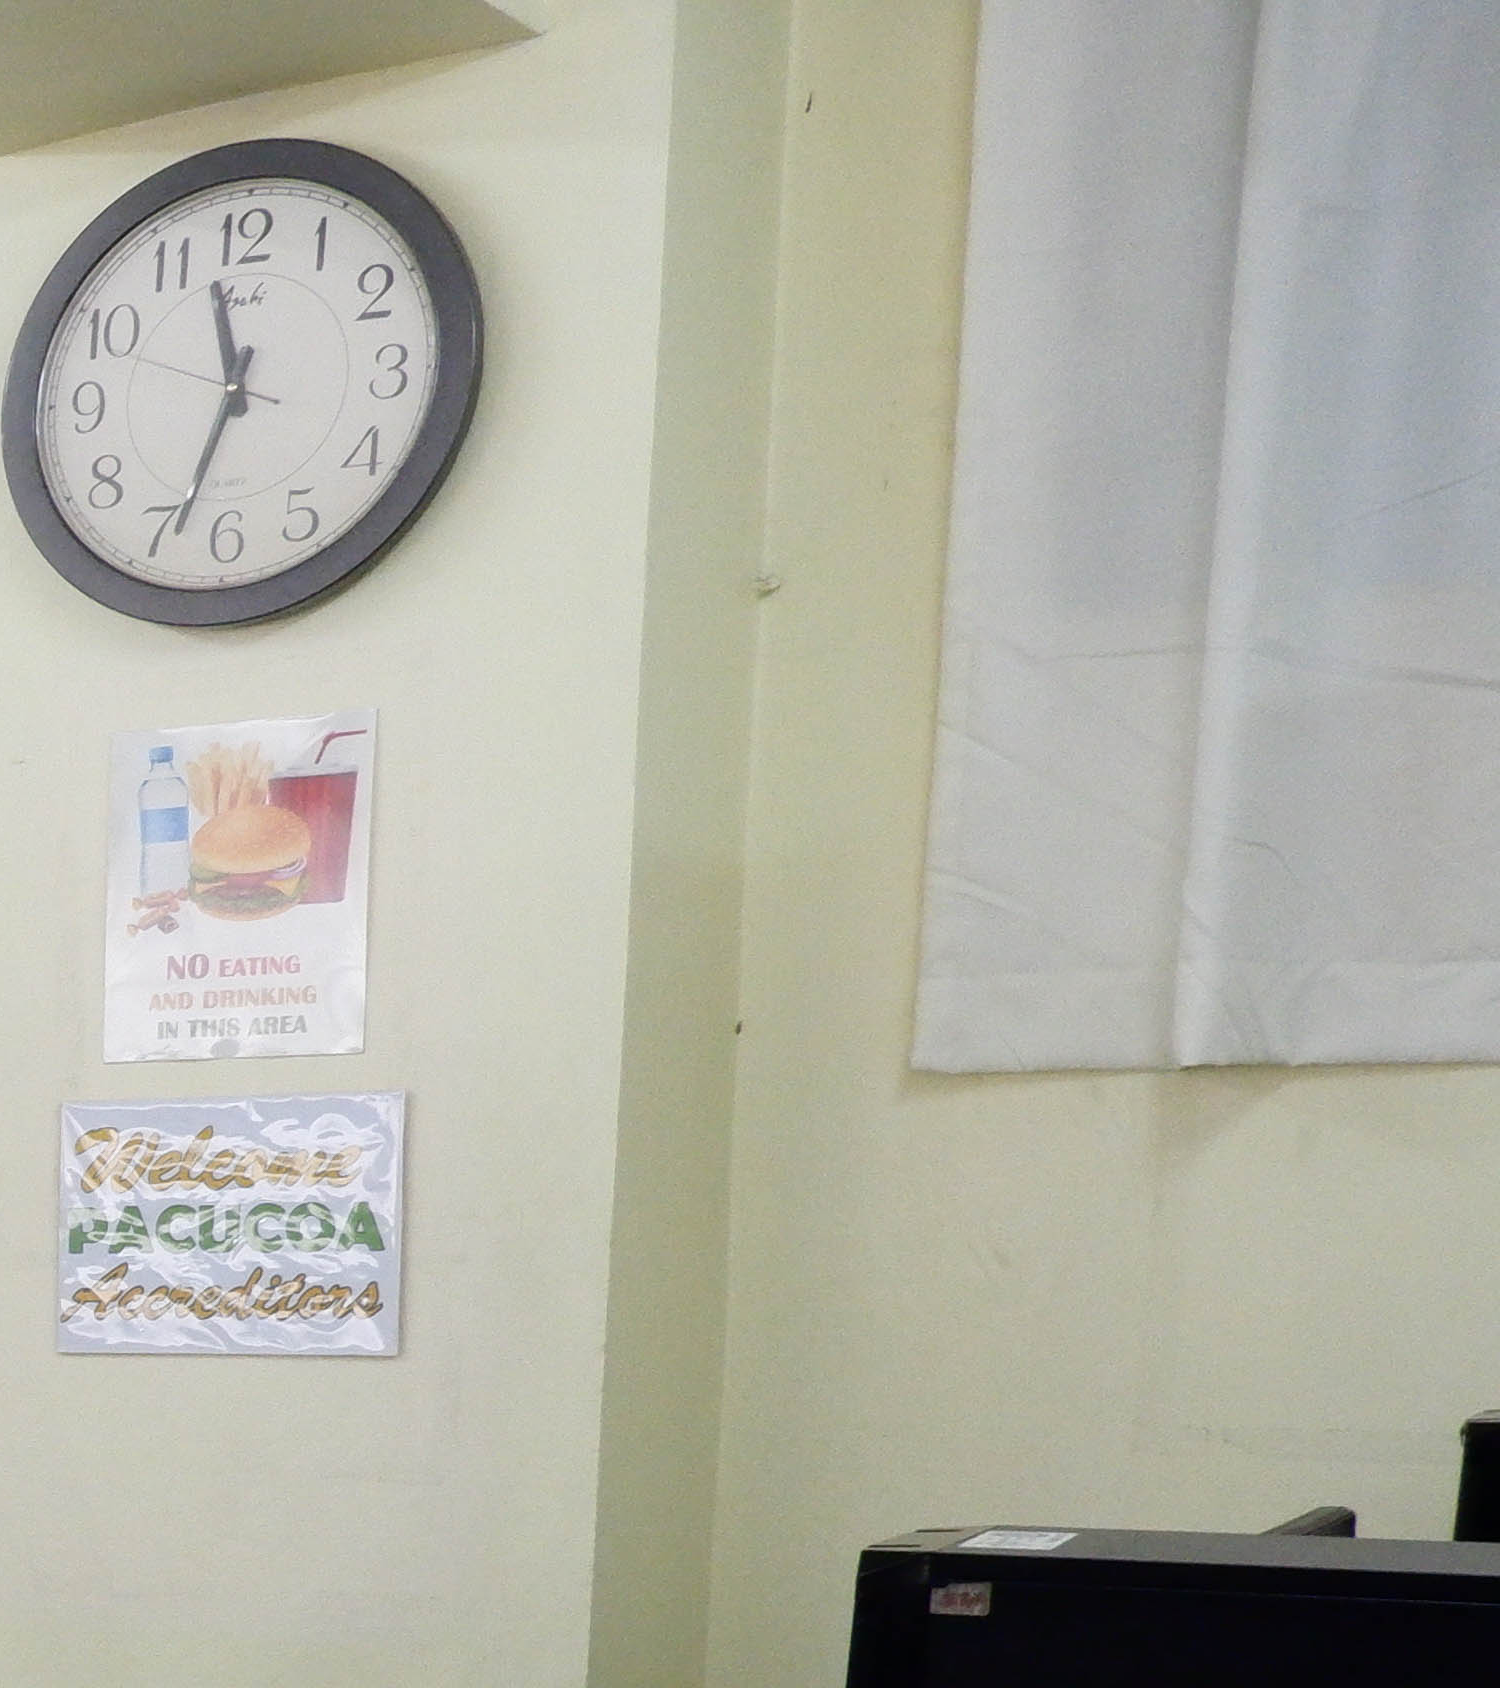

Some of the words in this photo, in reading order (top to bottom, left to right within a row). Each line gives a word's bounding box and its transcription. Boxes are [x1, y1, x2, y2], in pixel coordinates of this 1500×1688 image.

[221, 207, 274, 267] 12
[314, 216, 328, 272] 1
[154, 237, 191, 293] 11
[354, 263, 395, 322] 2
[89, 303, 141, 361] 10
[368, 343, 409, 400] 3
[72, 381, 106, 434] 9
[340, 425, 381, 476] 4
[88, 454, 124, 509] 8
[141, 503, 184, 558] 7
[209, 510, 245, 563] 6
[281, 486, 320, 542] 5
[166, 953, 210, 981] NO
[218, 954, 301, 979] EATING
[149, 989, 195, 1013] AND
[202, 984, 318, 1010] DRINKING
[157, 1020, 179, 1040] IN
[187, 1017, 240, 1039] THIS
[248, 1015, 308, 1037] AREA
[74, 1125, 365, 1193] Welcome
[67, 1201, 386, 1254] PACUCOA
[60, 1262, 384, 1323] Accreditors
